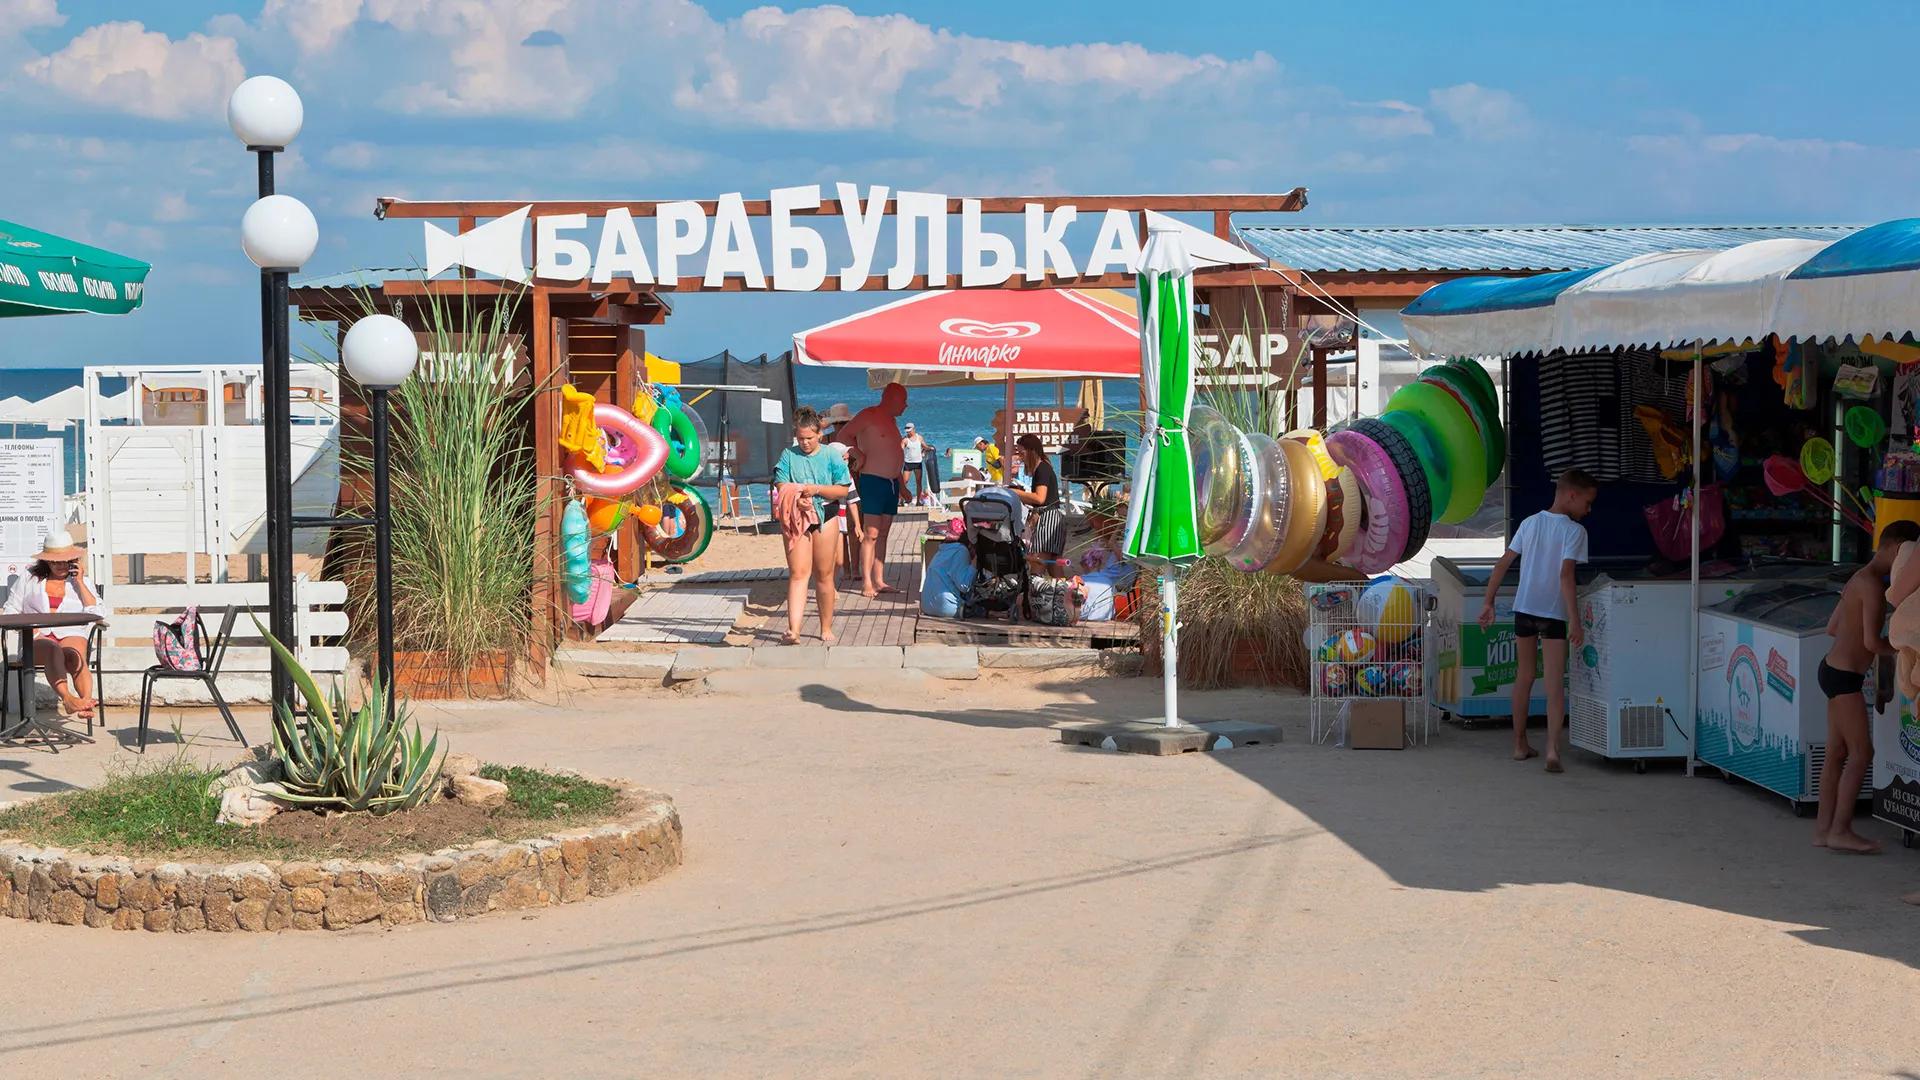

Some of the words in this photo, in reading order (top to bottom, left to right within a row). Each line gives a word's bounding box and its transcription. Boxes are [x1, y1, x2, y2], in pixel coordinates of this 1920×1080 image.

[537, 182, 1138, 291] БАРАБУЛЬКА
[939, 342, 1021, 368] Инмарко
[1194, 334, 1289, 368] БАР
[1016, 411, 1061, 422] РЫБА
